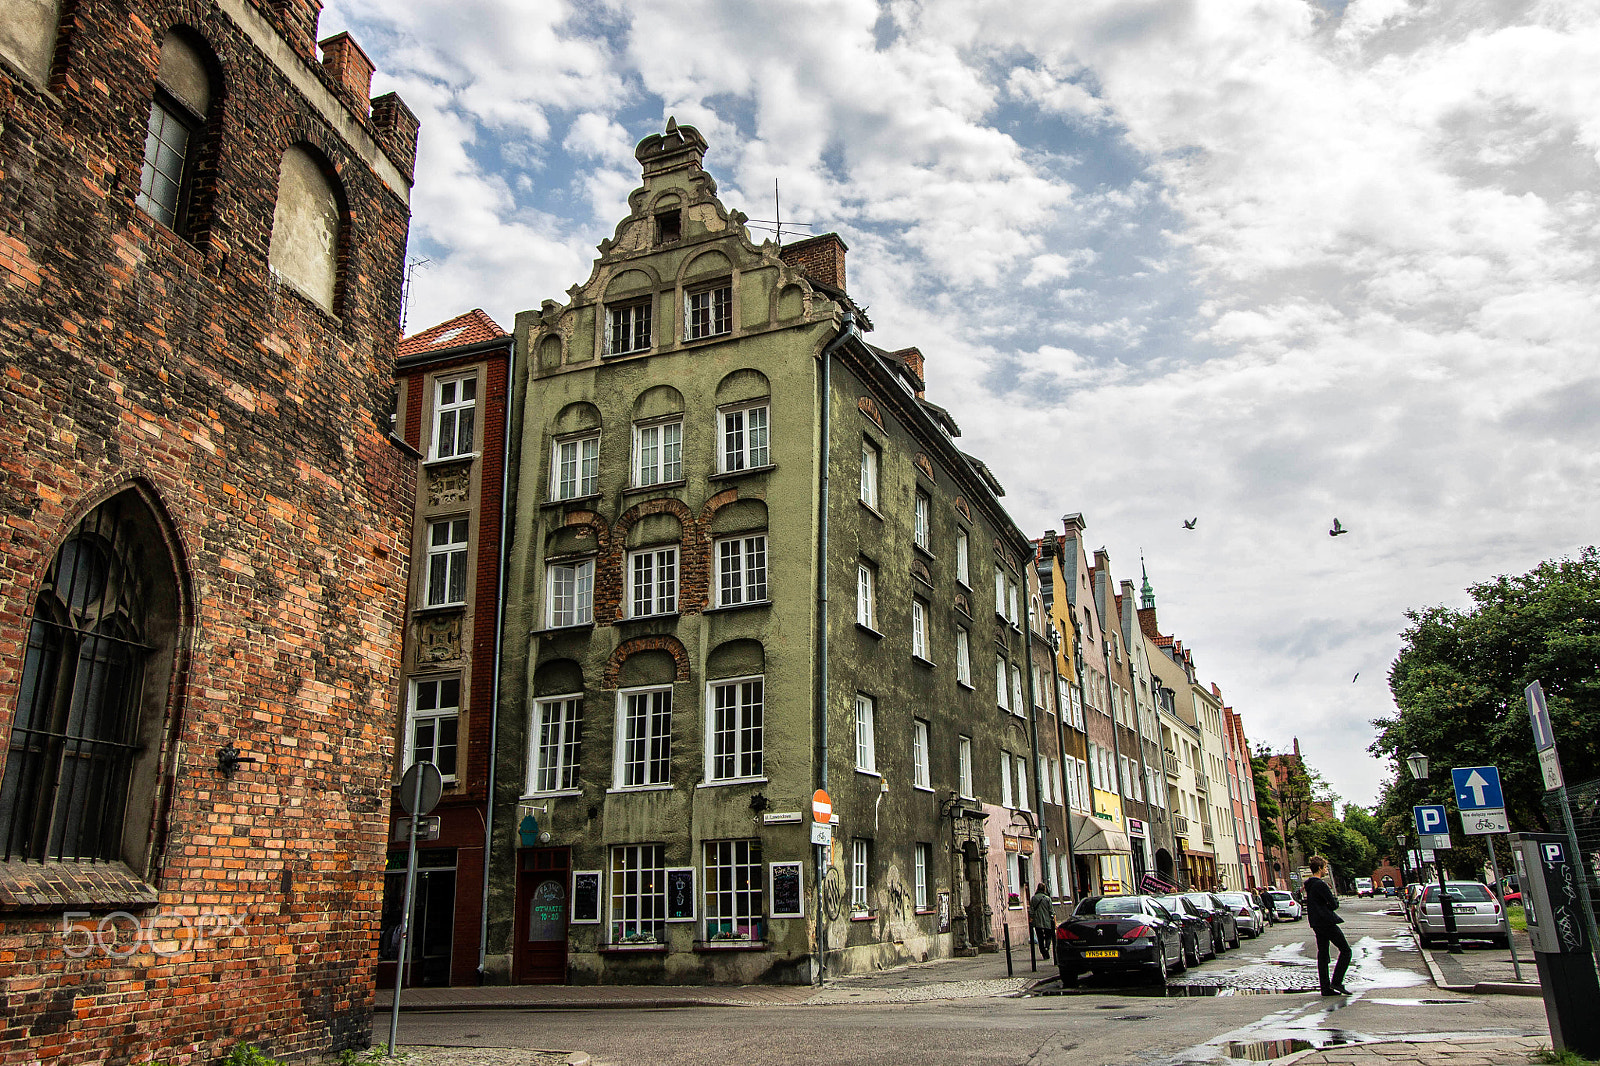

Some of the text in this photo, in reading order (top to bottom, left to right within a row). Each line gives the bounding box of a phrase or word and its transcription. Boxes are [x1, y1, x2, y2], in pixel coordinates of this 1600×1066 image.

[1421, 809, 1440, 831] P
[1545, 844, 1560, 861] P
[535, 905, 563, 913] OTWARTE
